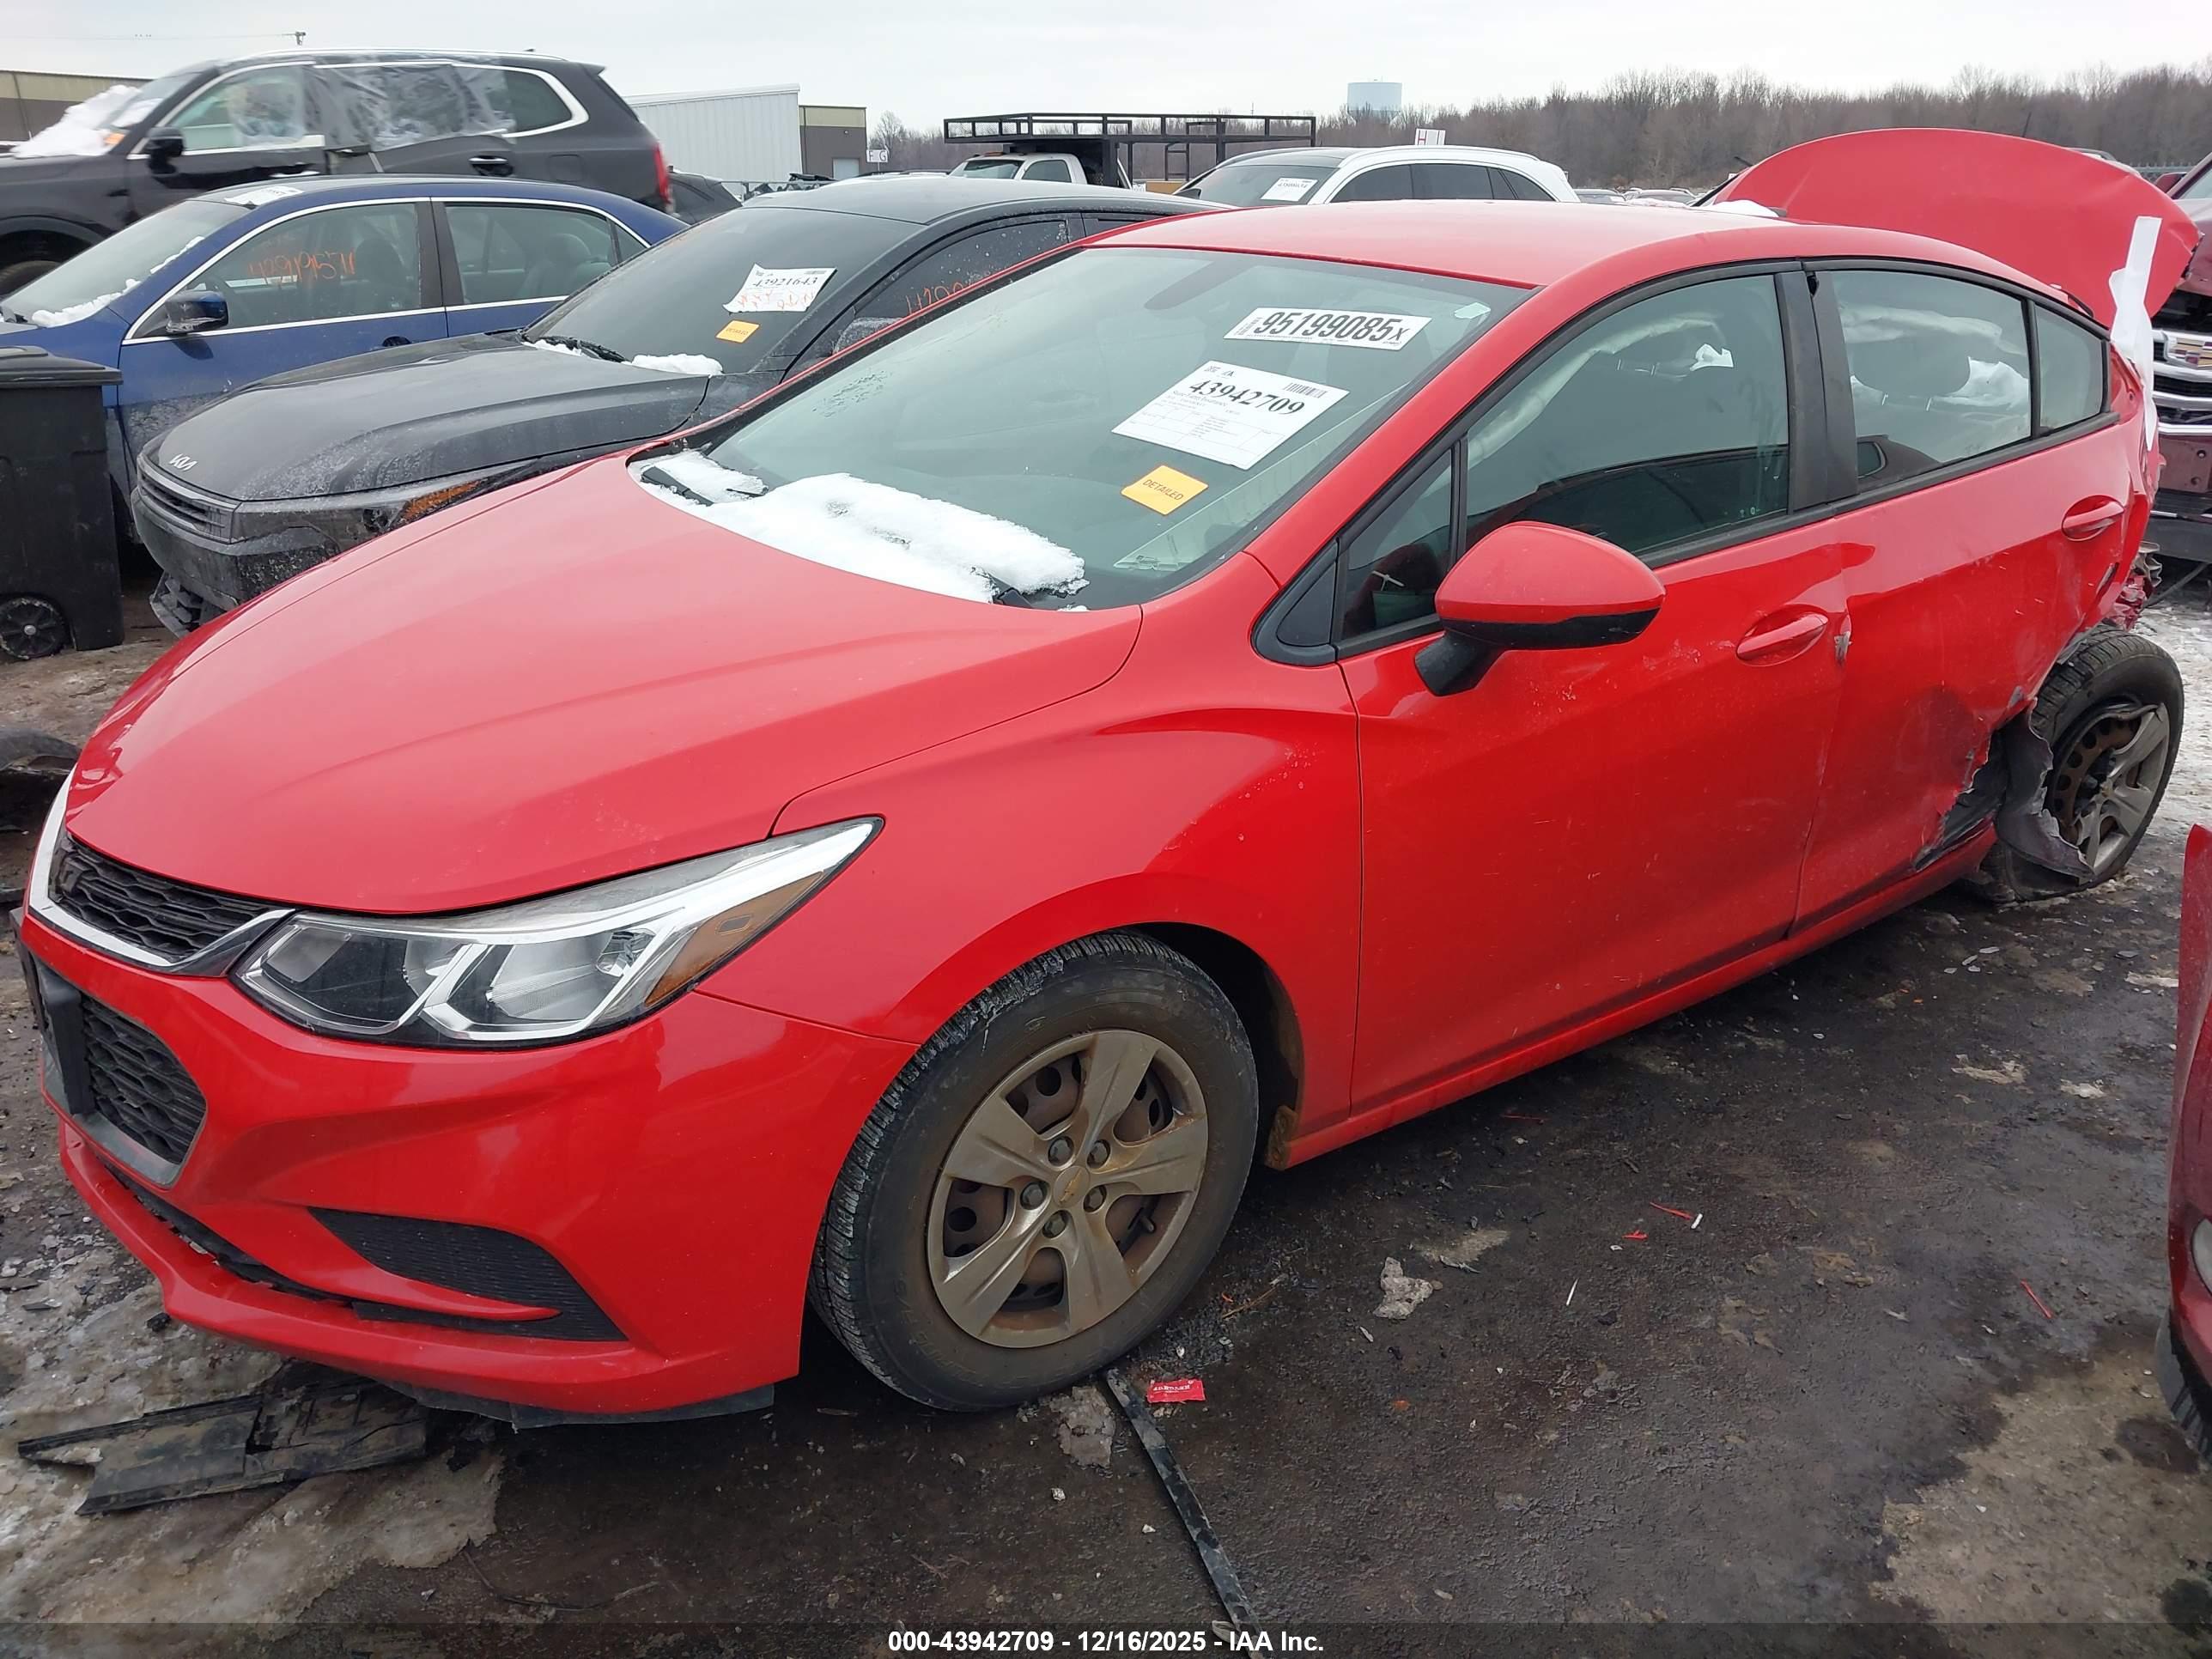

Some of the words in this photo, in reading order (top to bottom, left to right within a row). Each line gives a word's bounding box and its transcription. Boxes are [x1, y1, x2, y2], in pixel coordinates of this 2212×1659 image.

[1418, 130, 1427, 145] H
[868, 150, 874, 161] F
[879, 150, 887, 161] G
[1189, 380, 1305, 415] 43942709
[1142, 479, 1184, 501] DETAILED
